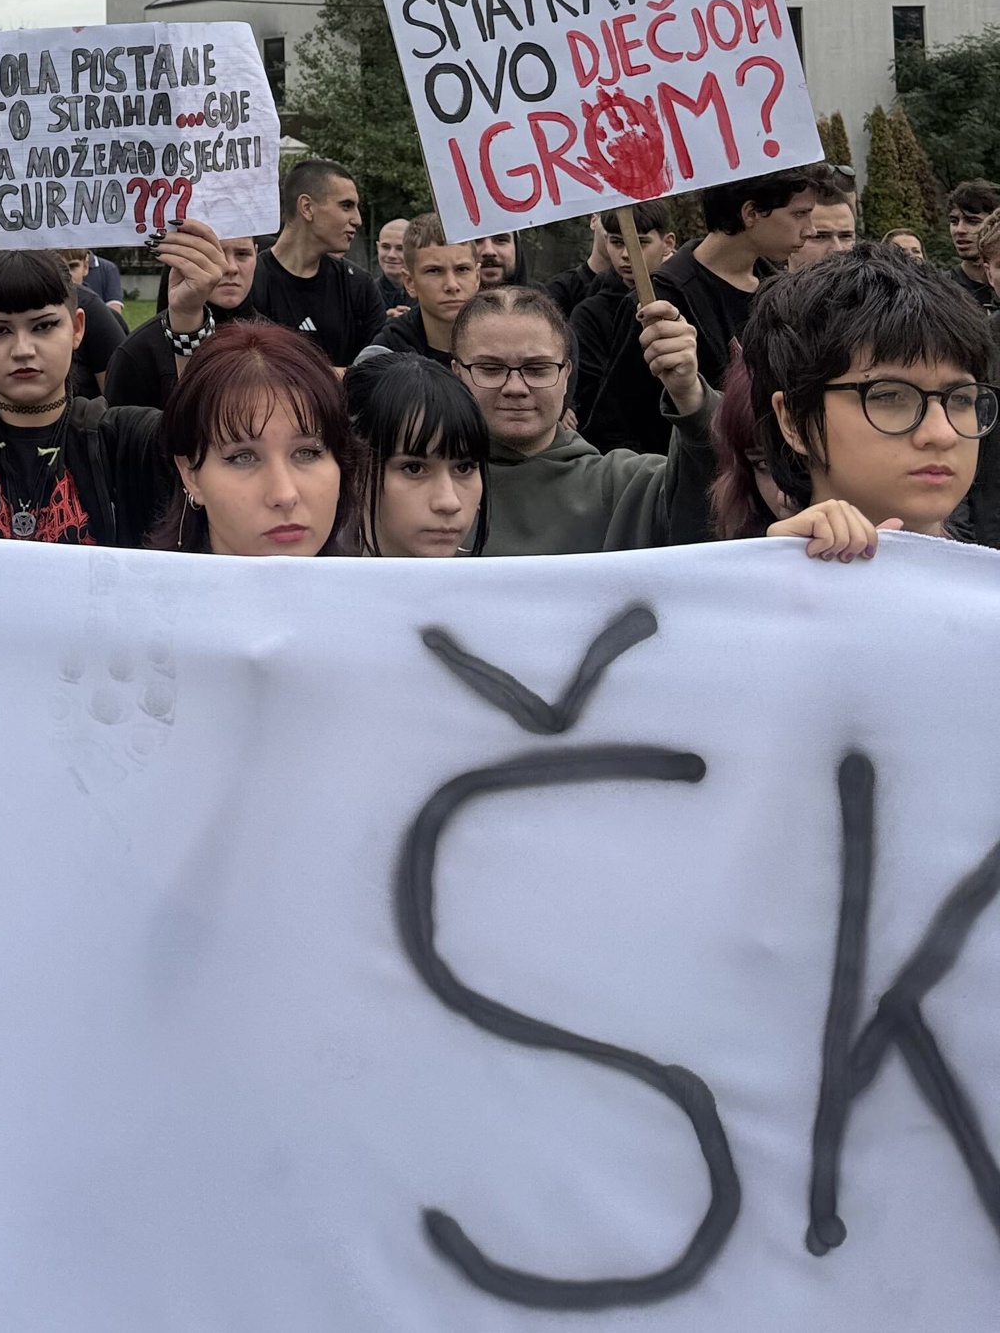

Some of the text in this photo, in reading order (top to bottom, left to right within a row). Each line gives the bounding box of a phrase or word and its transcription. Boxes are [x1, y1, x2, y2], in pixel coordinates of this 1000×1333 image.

[71, 43, 216, 95] POSTANE
[424, 42, 556, 124] OVO
[26, 137, 155, 179] MOŽEMO
[161, 131, 262, 185] OSJEĆATI
